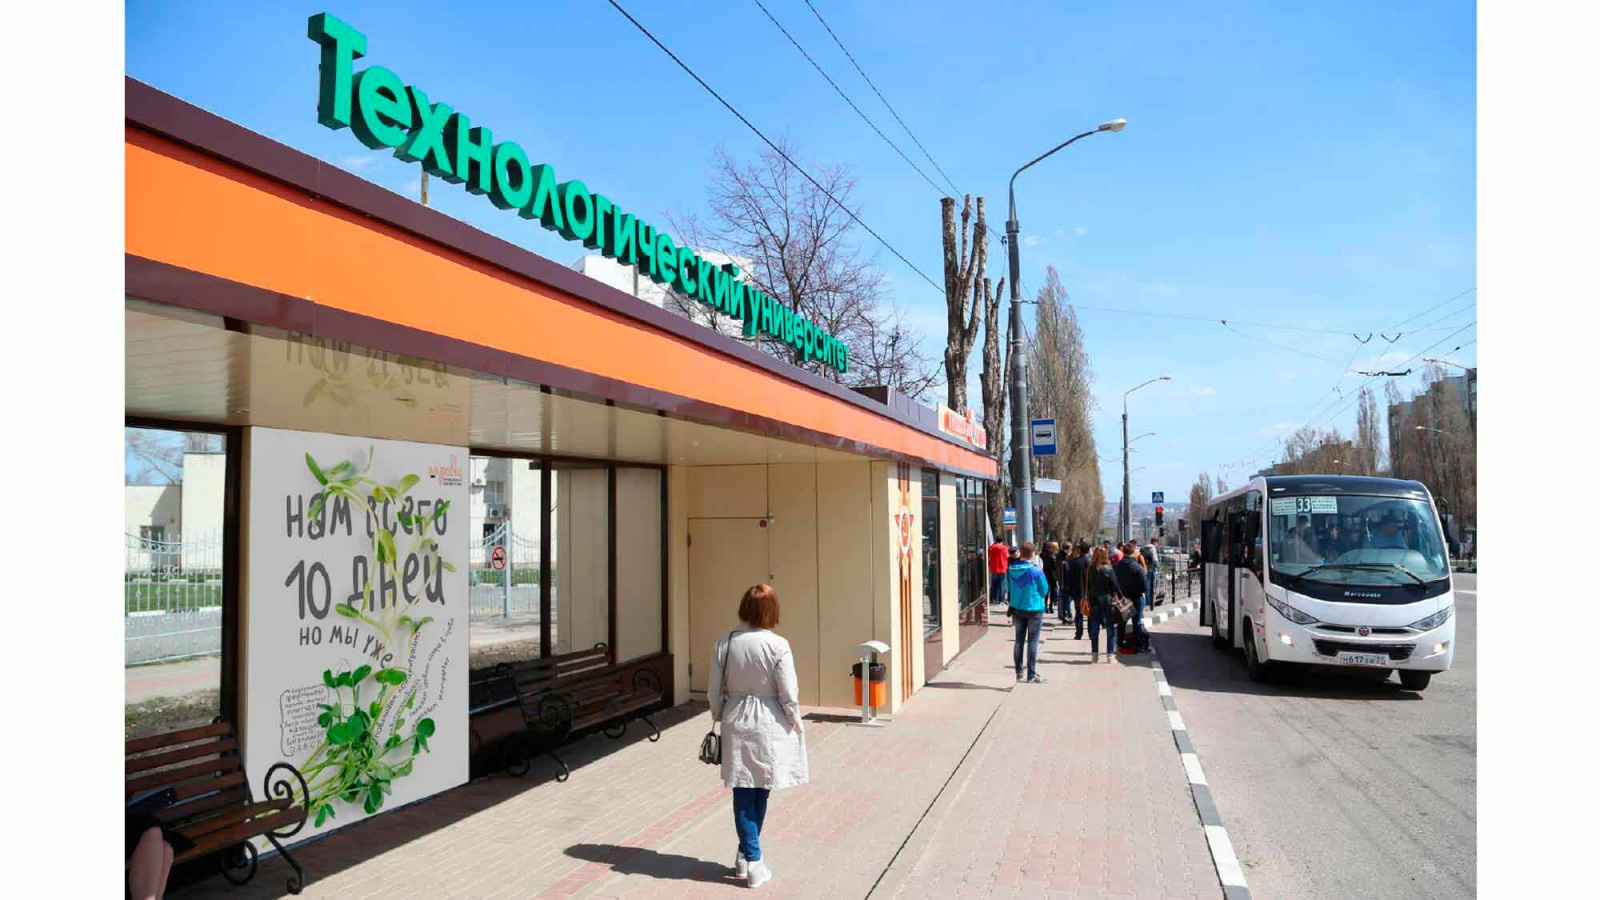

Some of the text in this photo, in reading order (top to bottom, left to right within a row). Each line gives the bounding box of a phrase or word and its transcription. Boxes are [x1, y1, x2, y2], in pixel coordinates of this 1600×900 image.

[308, 11, 850, 374] Технологический университет
[1297, 498, 1311, 513] 33
[284, 559, 331, 620] 10
[329, 625, 359, 649] мы
[362, 635, 393, 669] уже
